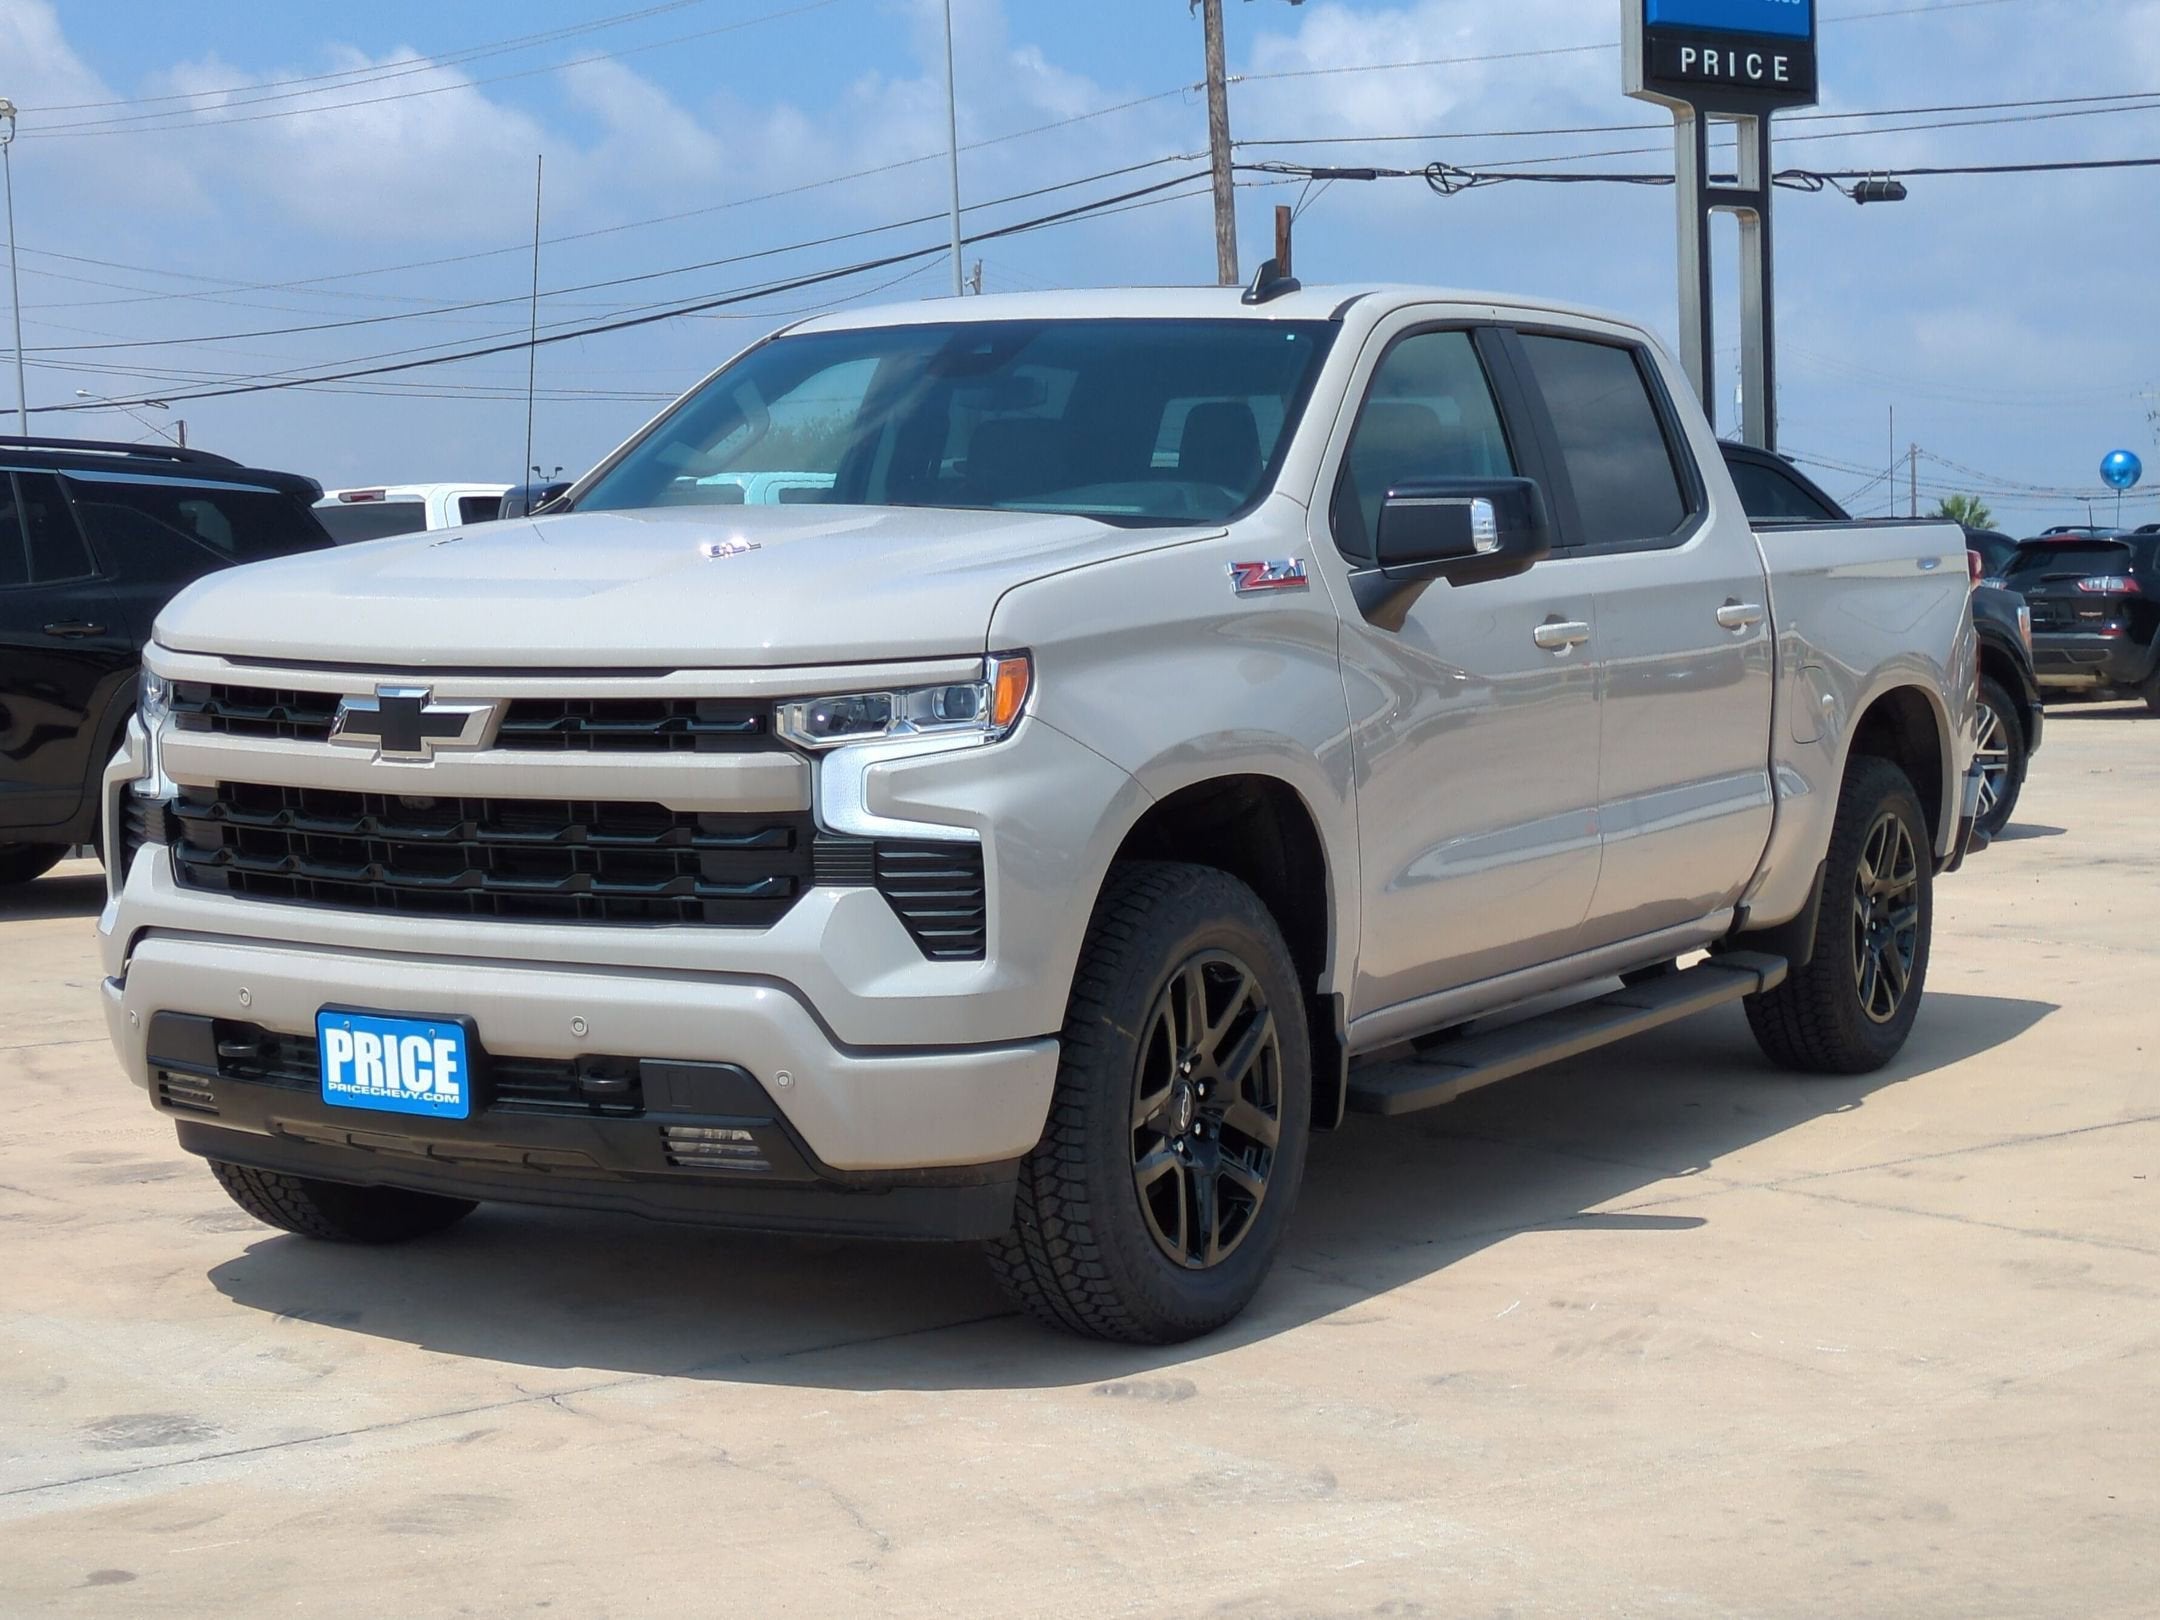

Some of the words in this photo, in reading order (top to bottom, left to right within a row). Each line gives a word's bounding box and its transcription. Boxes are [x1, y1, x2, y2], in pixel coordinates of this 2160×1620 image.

[1681, 47, 1789, 82] PRICE
[1225, 558, 1308, 592] Z71
[325, 1028, 460, 1095] PRICE
[328, 1082, 460, 1104] PRICECHEVY.COM
